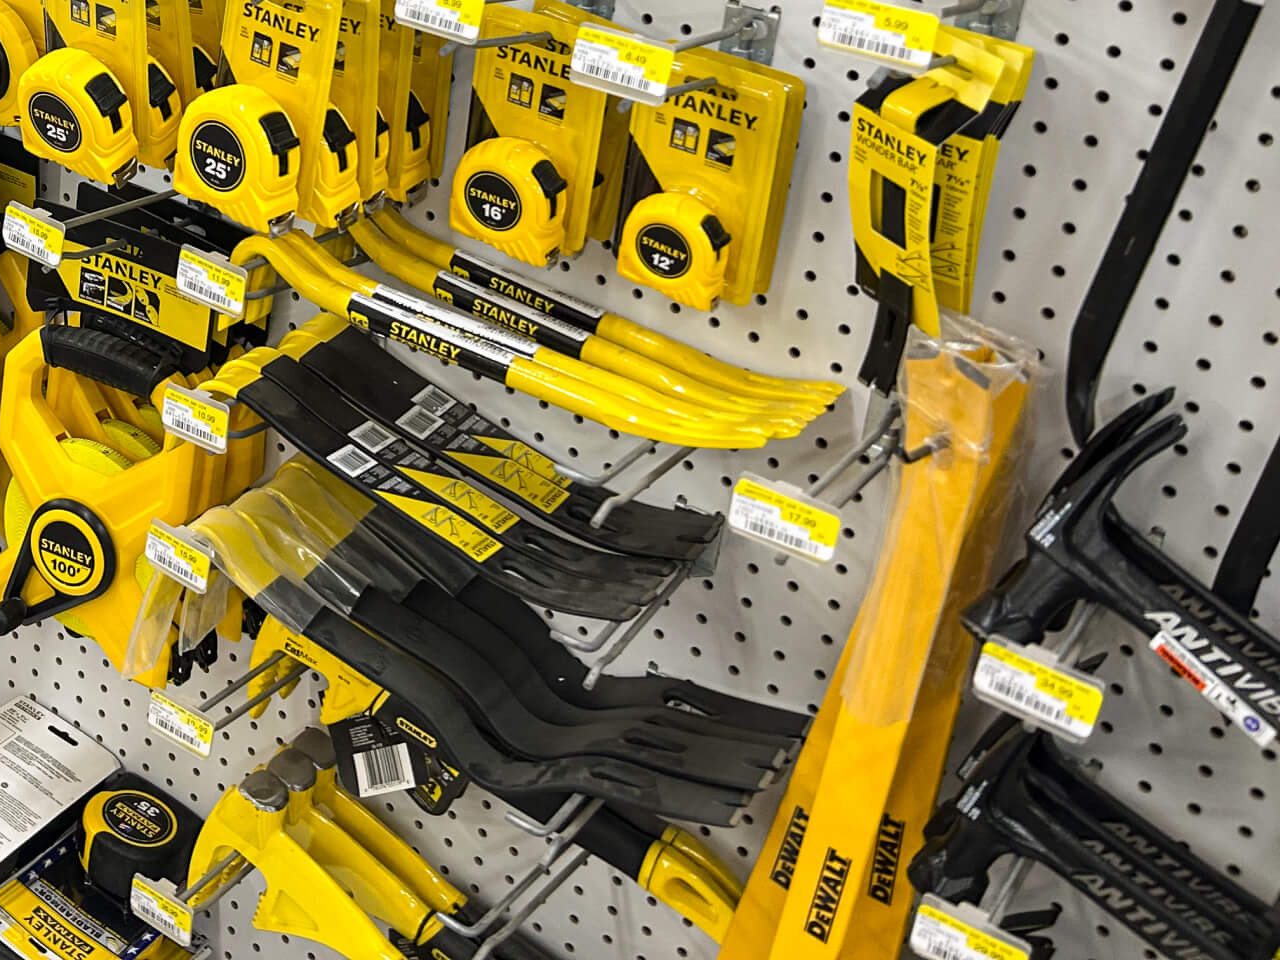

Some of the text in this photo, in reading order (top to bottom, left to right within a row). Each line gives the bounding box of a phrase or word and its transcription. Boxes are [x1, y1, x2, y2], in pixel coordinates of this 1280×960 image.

[443, 0, 462, 10] 8.99
[243, 1, 319, 42] STANLEY
[883, 16, 909, 32] 5.99
[497, 44, 572, 81] STANLE
[33, 108, 75, 132] STANLEY
[46, 123, 70, 142] 25'
[195, 138, 241, 168] STANLEY
[856, 134, 898, 166] WONDER
[857, 116, 926, 168] STANLEY
[204, 158, 231, 181] 25'
[469, 187, 518, 211] STANLEY
[482, 202, 506, 221] 16'
[642, 235, 688, 262] STANLEY
[652, 251, 675, 270] 12'
[81, 256, 162, 290] STANLEY
[212, 272, 231, 288] 11.99
[490, 276, 555, 315] STANLEY
[473, 298, 540, 336] STANLEY
[390, 321, 462, 361] STANLEY
[789, 511, 818, 529] 17.99
[41, 536, 92, 567] STANLEY
[50, 556, 81, 578] 100'
[1145, 611, 1280, 724] ANTIVIB
[18, 699, 48, 719] STANLEY
[396, 717, 436, 747] STANLEY
[137, 800, 159, 816] 35'
[110, 808, 155, 838] STANLEY
[35, 908, 93, 953] FATMAX
